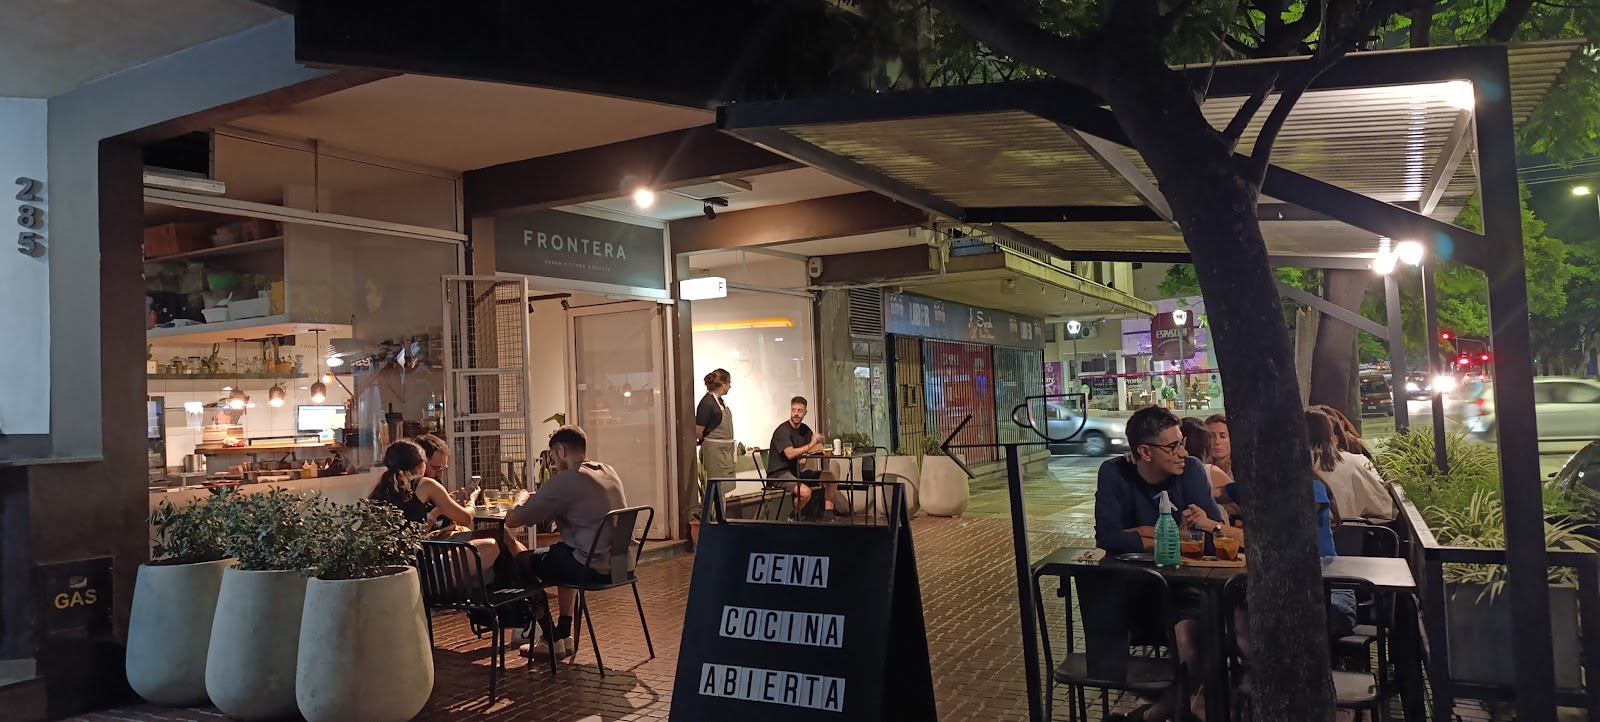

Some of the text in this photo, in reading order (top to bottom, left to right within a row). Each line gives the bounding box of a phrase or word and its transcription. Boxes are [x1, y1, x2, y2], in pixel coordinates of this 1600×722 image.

[15, 176, 40, 256] 285
[523, 230, 627, 260] FRONTERA
[718, 281, 724, 292] F
[751, 554, 824, 586] CENA
[54, 588, 97, 609] GAS
[724, 608, 839, 646] COCINA
[703, 665, 839, 710] ABIERTA
